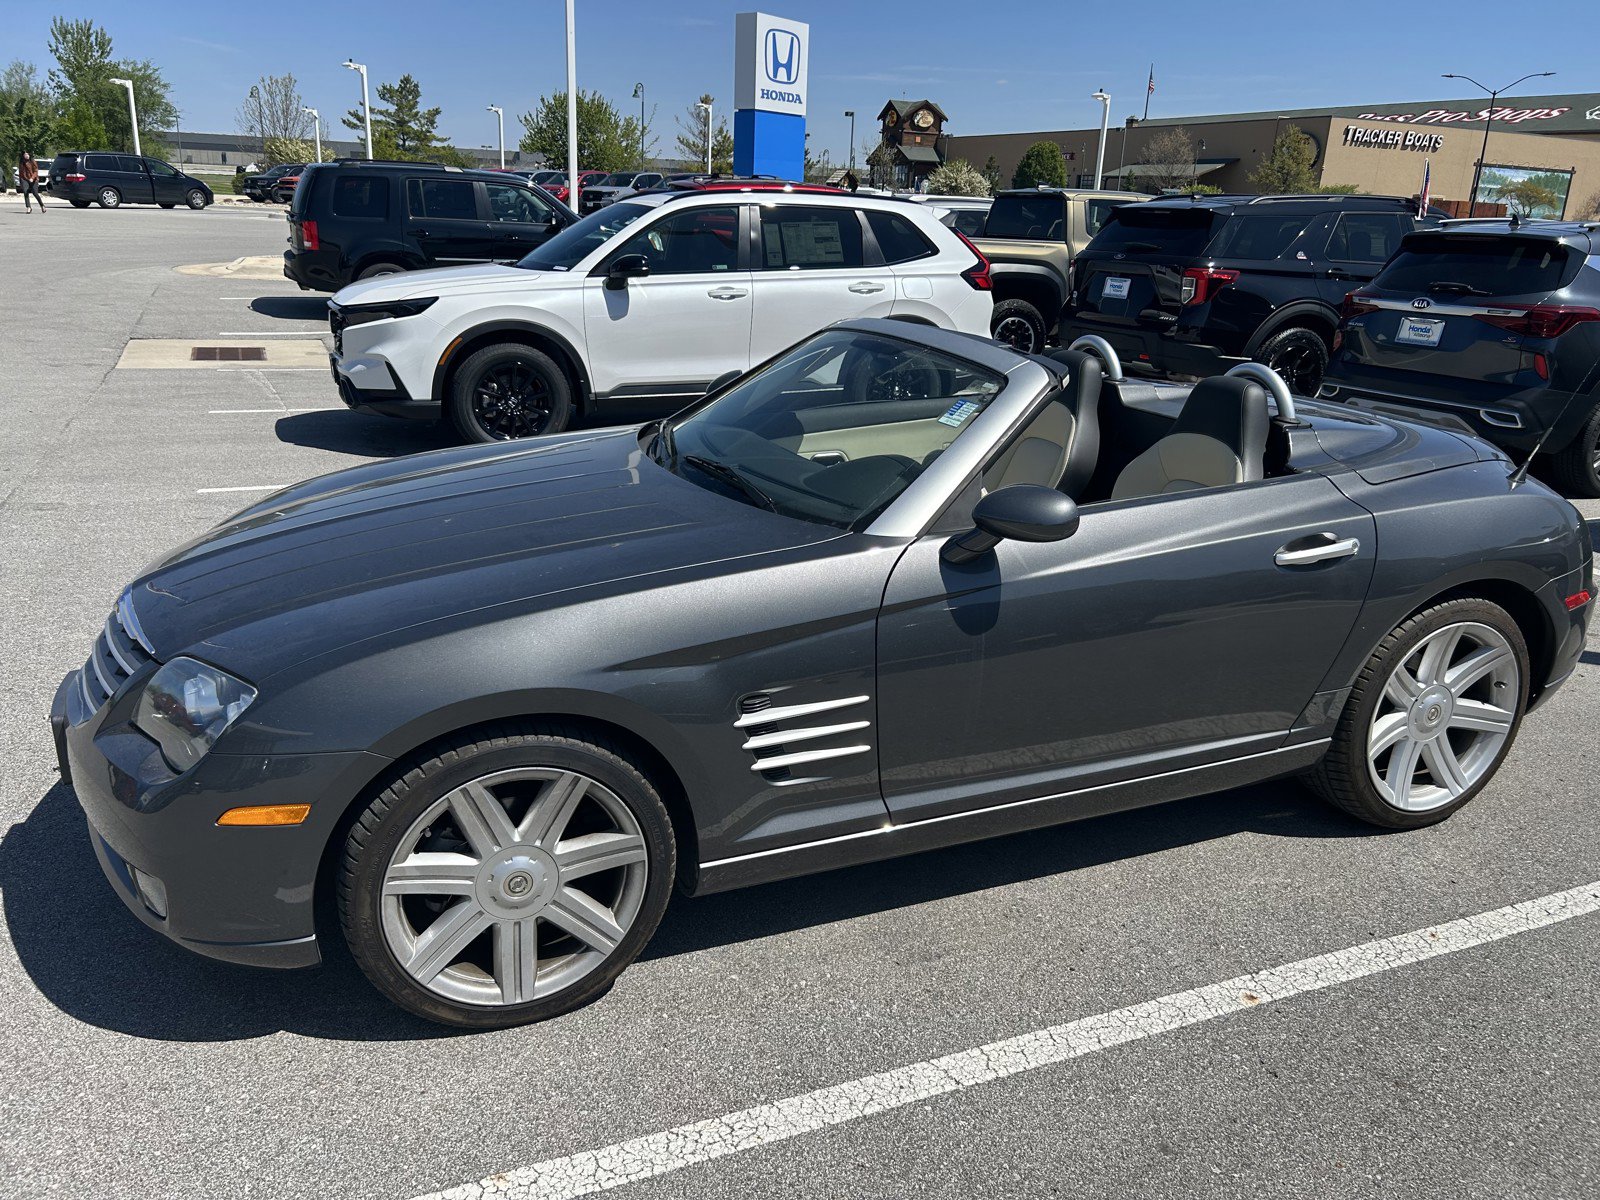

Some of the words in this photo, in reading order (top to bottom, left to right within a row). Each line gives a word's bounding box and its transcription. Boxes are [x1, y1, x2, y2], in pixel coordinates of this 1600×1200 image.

[760, 88, 803, 104] HONDA
[1410, 109, 1466, 123] Pro
[1466, 106, 1571, 124] Shops
[1347, 125, 1402, 145] TRACKER
[1405, 130, 1444, 148] BOATS
[1413, 300, 1428, 308] KIA
[1408, 325, 1431, 333] Honda
